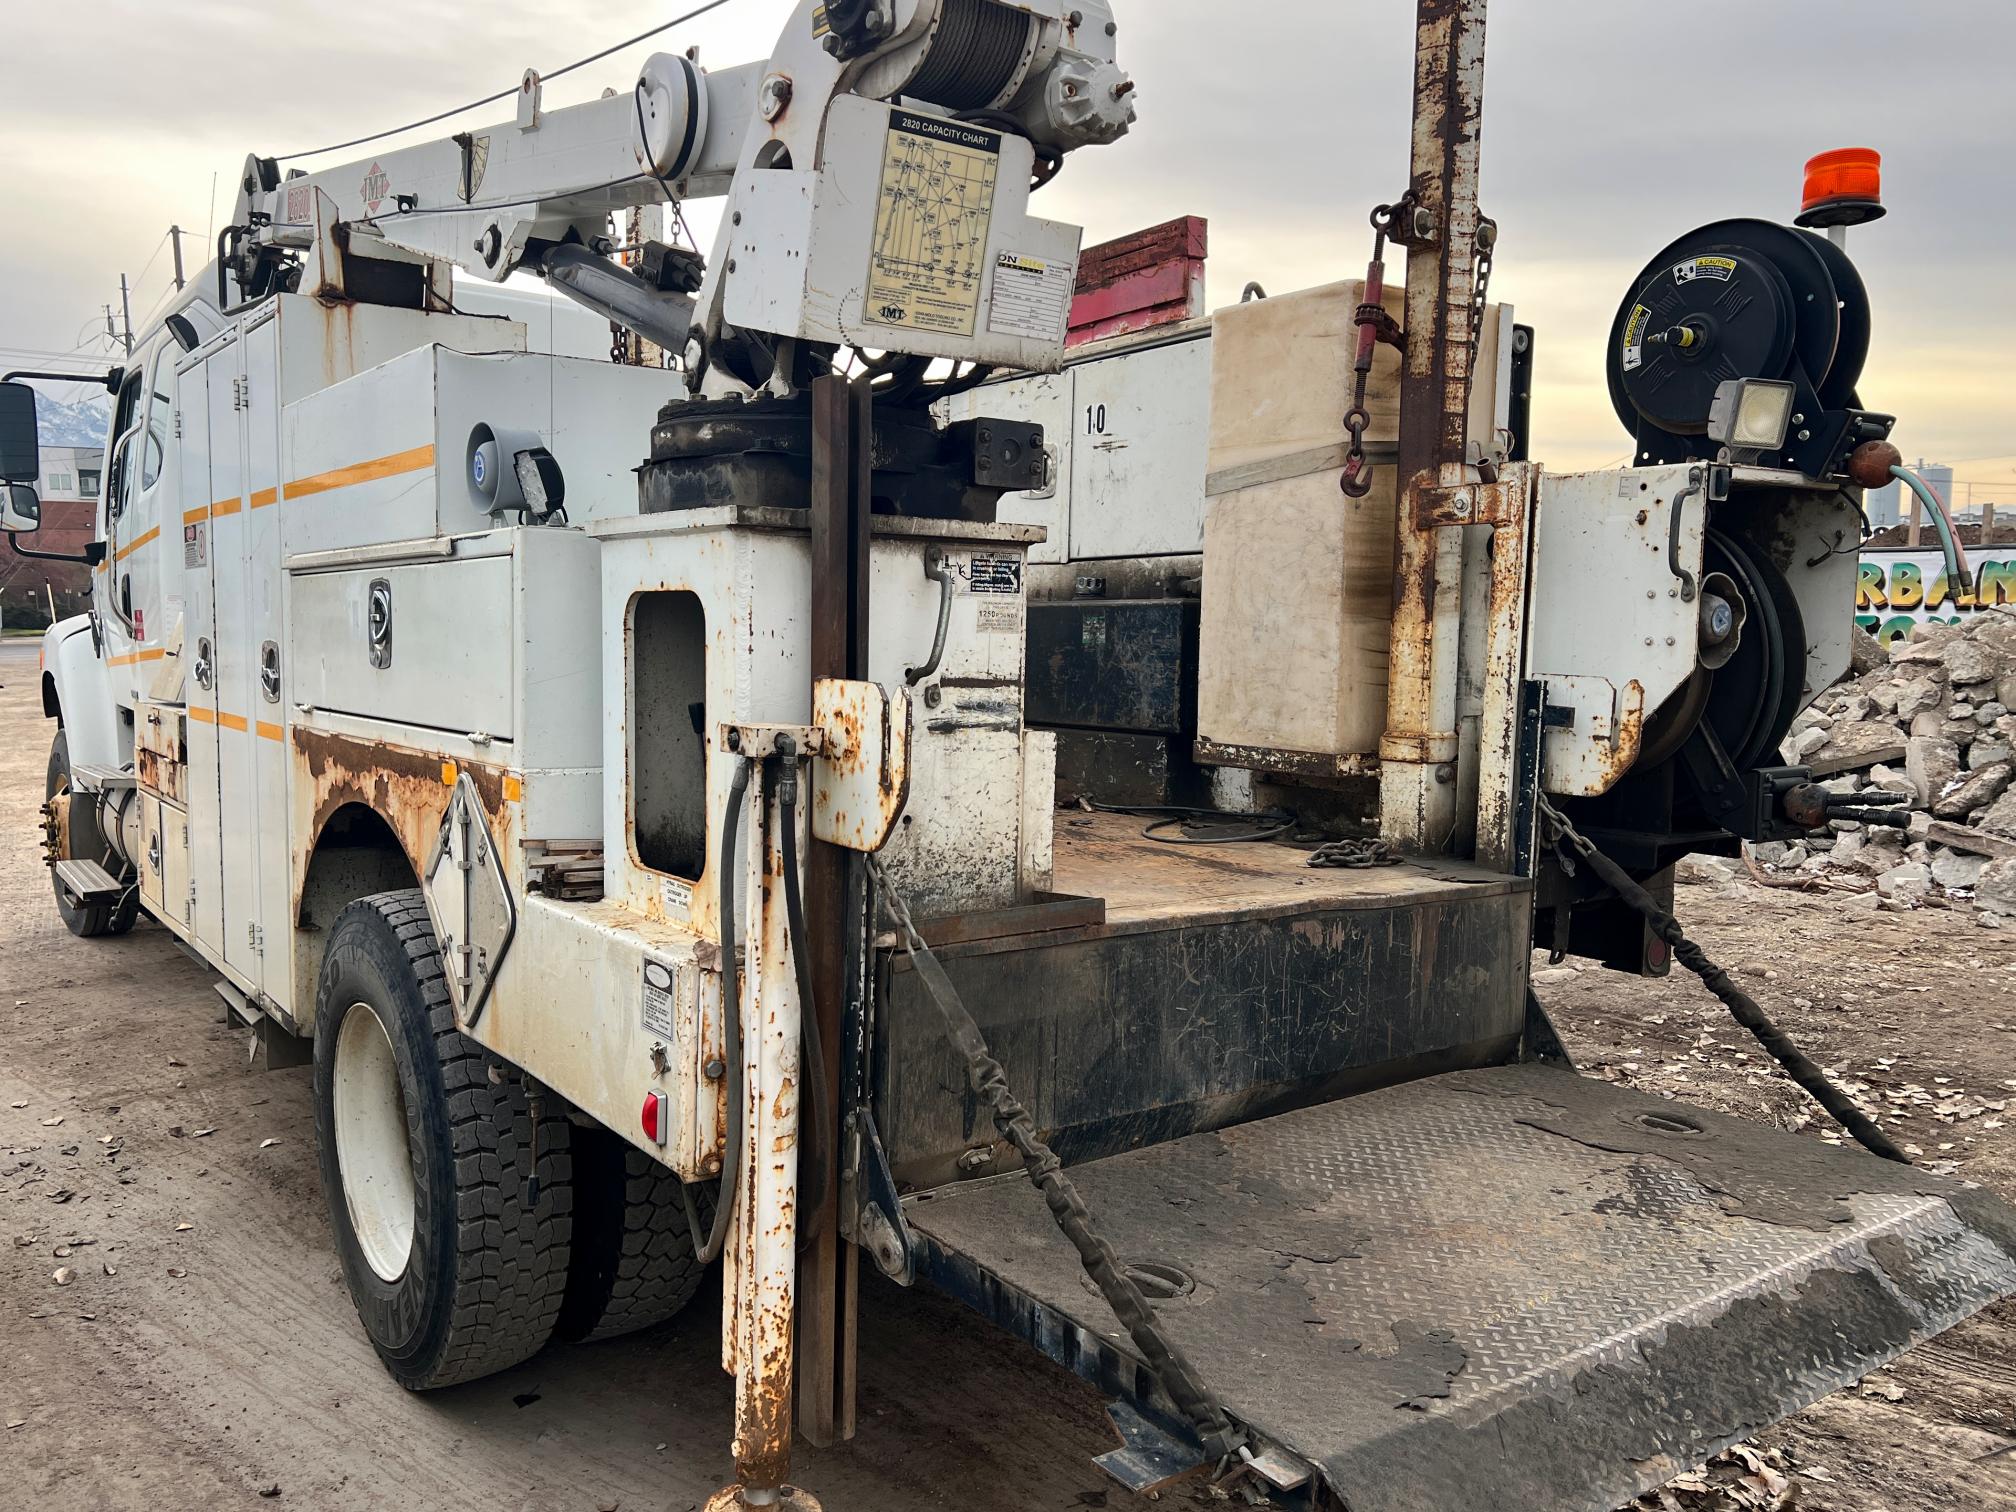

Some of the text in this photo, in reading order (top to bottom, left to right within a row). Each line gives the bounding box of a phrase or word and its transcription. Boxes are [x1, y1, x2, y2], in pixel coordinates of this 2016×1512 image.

[902, 118, 989, 146] 2820 CAPACITY CHART
[363, 172, 387, 202] IMT
[1704, 259, 1732, 267] CAUTION
[881, 305, 904, 319] IMT
[986, 553, 1013, 561] WARNING
[979, 610, 996, 618] 1250
